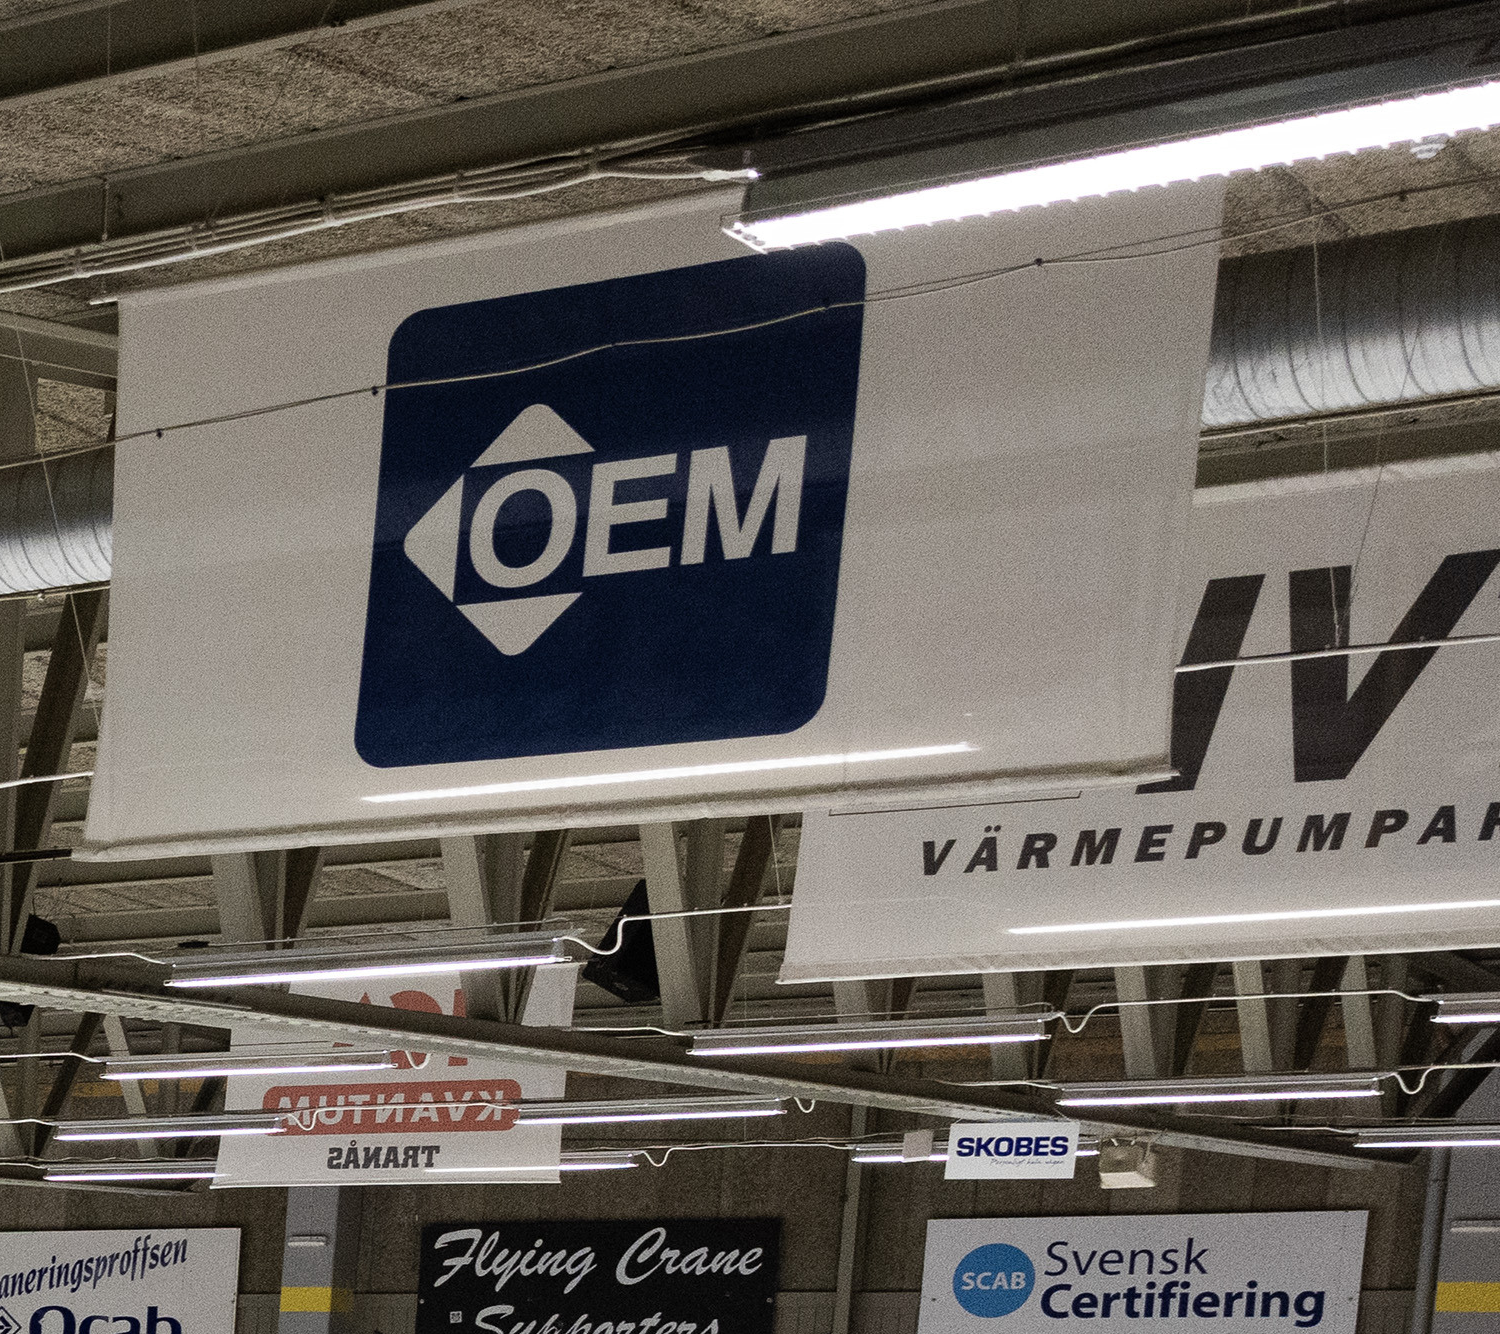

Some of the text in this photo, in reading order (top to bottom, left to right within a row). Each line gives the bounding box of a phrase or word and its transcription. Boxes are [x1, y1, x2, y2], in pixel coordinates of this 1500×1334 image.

[469, 435, 806, 587] OEM
[956, 1136, 1069, 1157] SKOBES
[433, 1226, 763, 1294] Flying Crane
[961, 1238, 1210, 1290] SCAB Svensk
[1040, 1281, 1326, 1328] Certifiering
